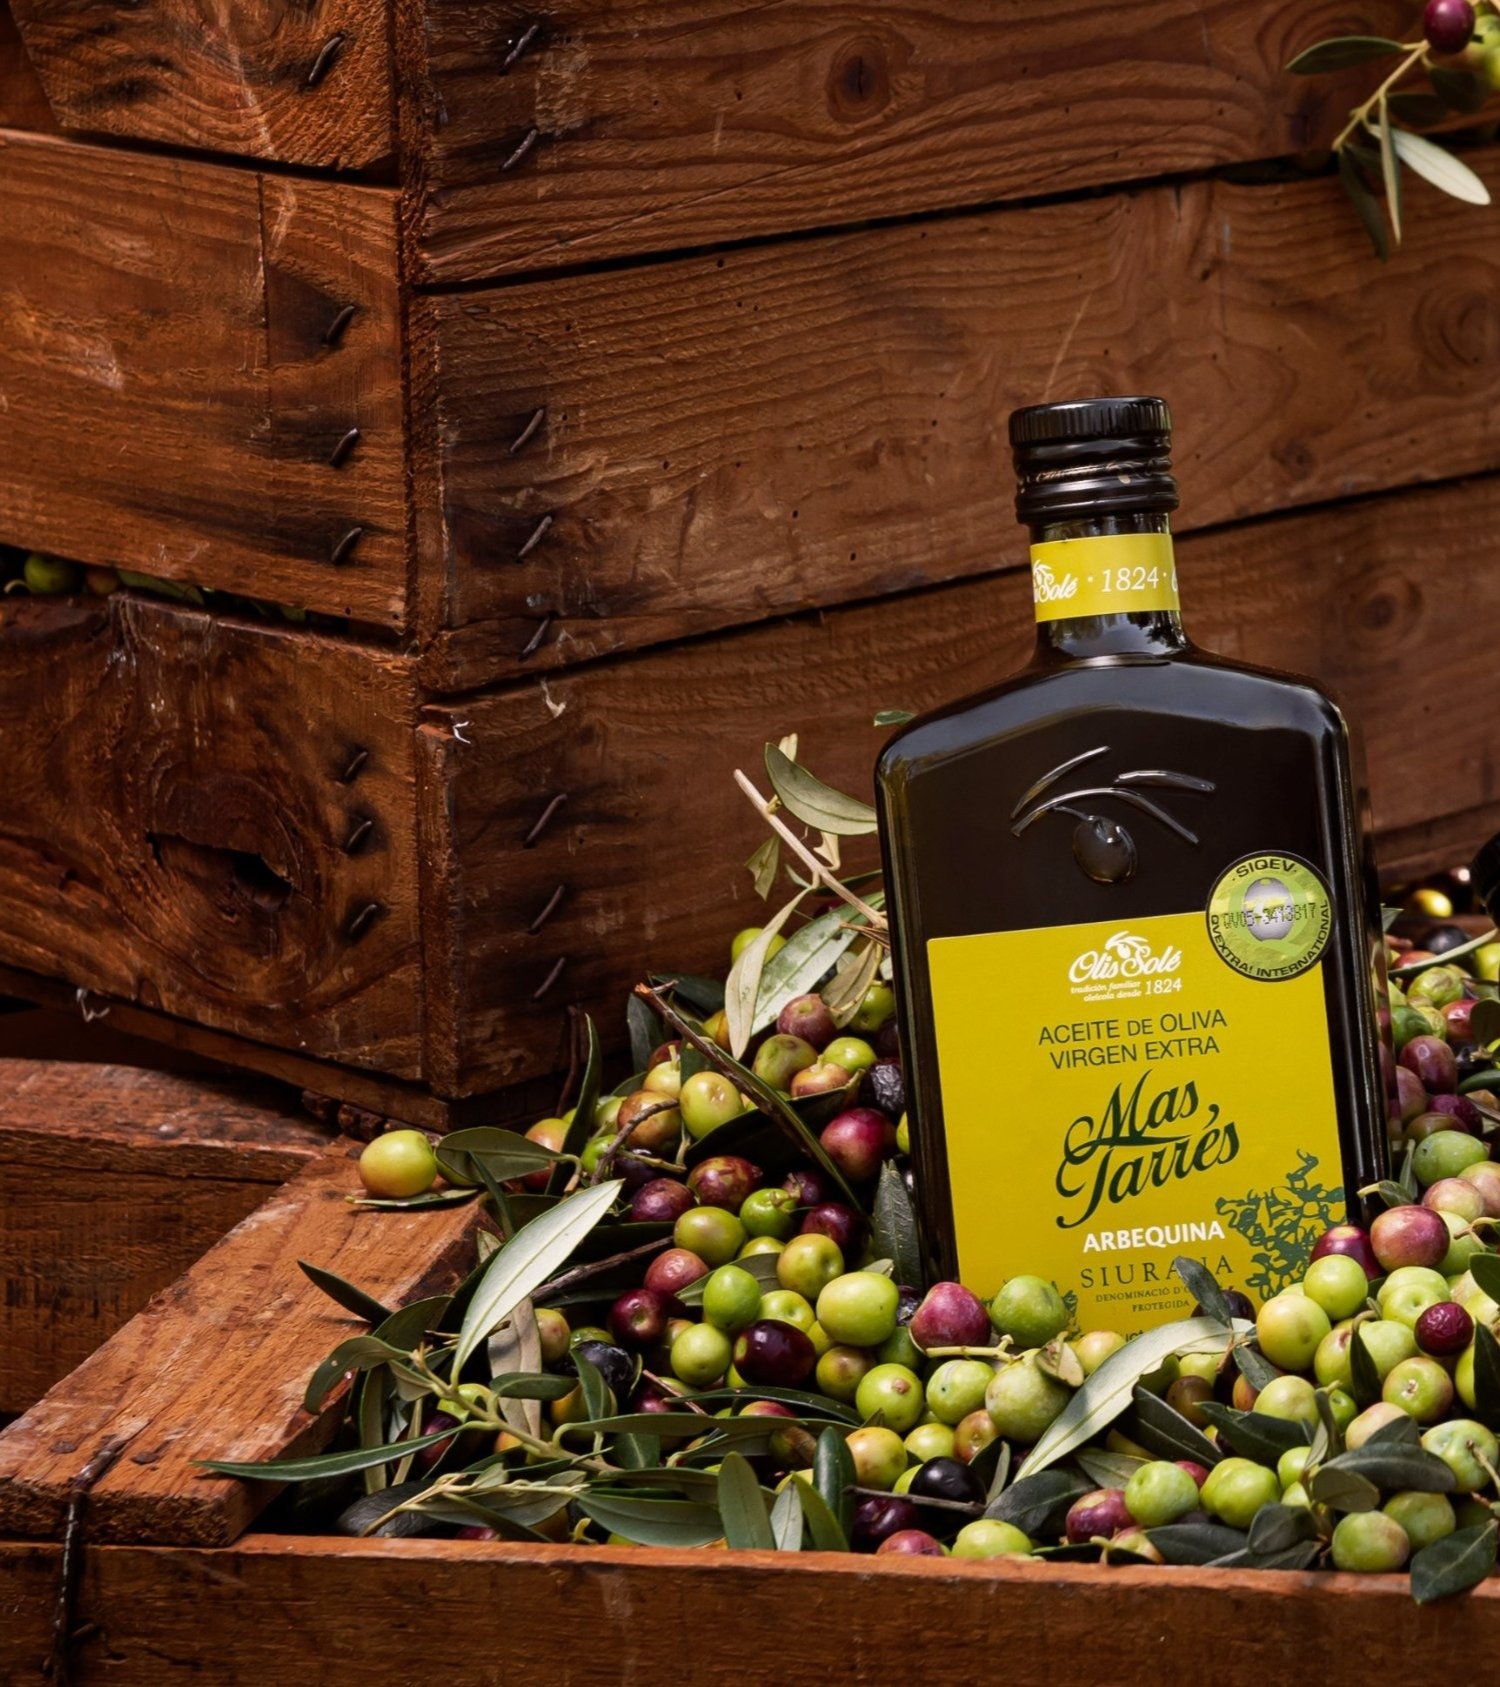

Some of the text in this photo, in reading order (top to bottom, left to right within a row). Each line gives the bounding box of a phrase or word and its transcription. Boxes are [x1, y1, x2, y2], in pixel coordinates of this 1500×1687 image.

[1102, 566, 1159, 592] 1824
[1236, 859, 1295, 878] SIQEV
[1211, 899, 1330, 977] QVEXTRA! INTERNATIONAL
[1145, 977, 1182, 995] 1824
[1039, 1008, 1227, 1045] ACEITE DE OLIVA
[1050, 1035, 1220, 1069] VIRGEN EXTRA
[1063, 1069, 1199, 1165] Mas
[1082, 1220, 1226, 1253] ARBEQUINA
[1096, 1287, 1170, 1303] DENOMINACIÓ
[1132, 1299, 1190, 1313] PROTEGIDA
